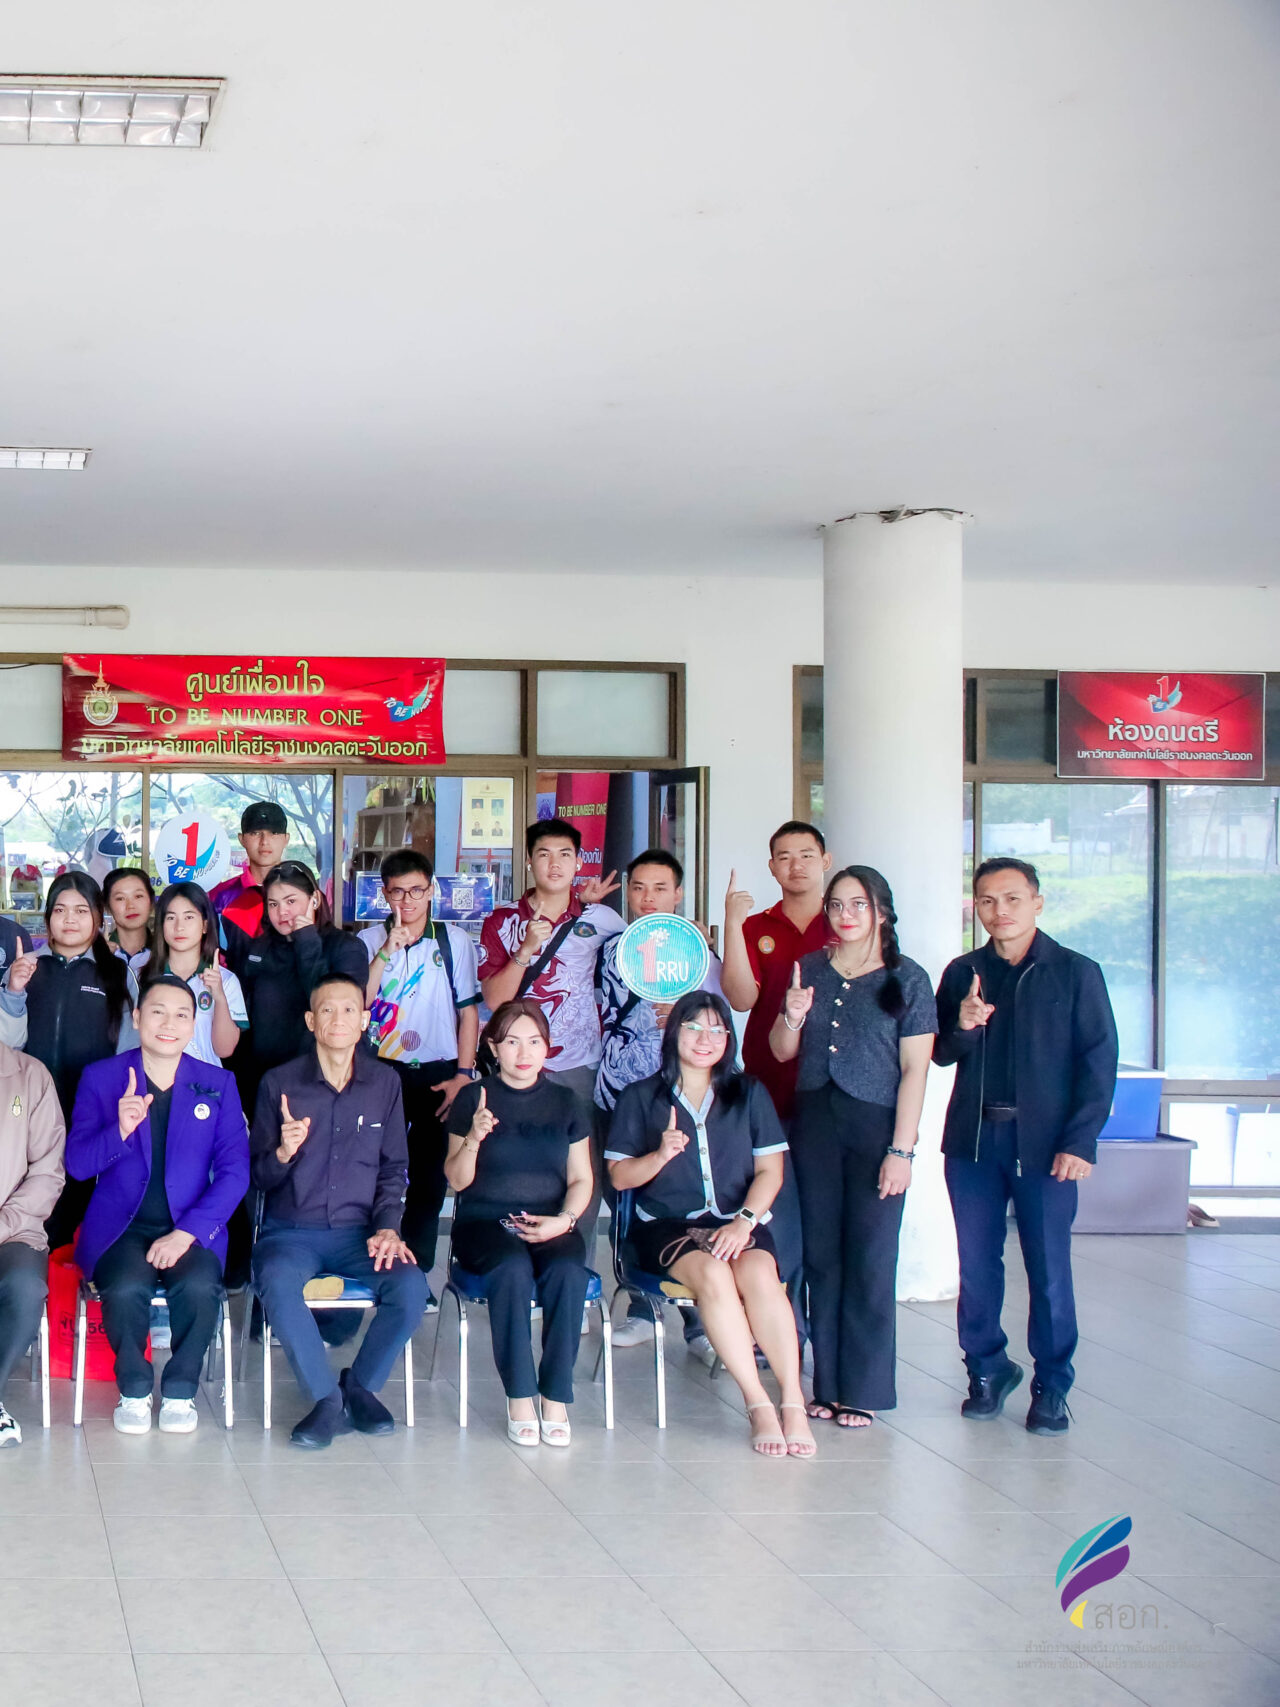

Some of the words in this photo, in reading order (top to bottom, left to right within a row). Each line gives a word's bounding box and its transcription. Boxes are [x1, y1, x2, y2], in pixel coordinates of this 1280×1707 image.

[186, 660, 325, 702] ศูนย์เพื่อนใจ
[147, 706, 177, 725] TO
[187, 707, 211, 726] BE
[221, 707, 309, 726] NUMBER
[320, 708, 363, 726] ONE
[394, 707, 408, 717] BE
[1108, 717, 1219, 743] ห้องดนตรี
[81, 731, 428, 758] มหาวิทยาลัยเทคโนโลยีราชมงคลตะวันออก
[1077, 748, 1253, 761] มหาวิทยาลัยเทคโนโลยีราชมงคลตะวันออก
[558, 806, 566, 817] TO
[566, 805, 573, 817] BE
[573, 804, 595, 816] NUMBER
[596, 803, 607, 816] ONE
[181, 822, 199, 866] 1
[174, 866, 191, 878] BE
